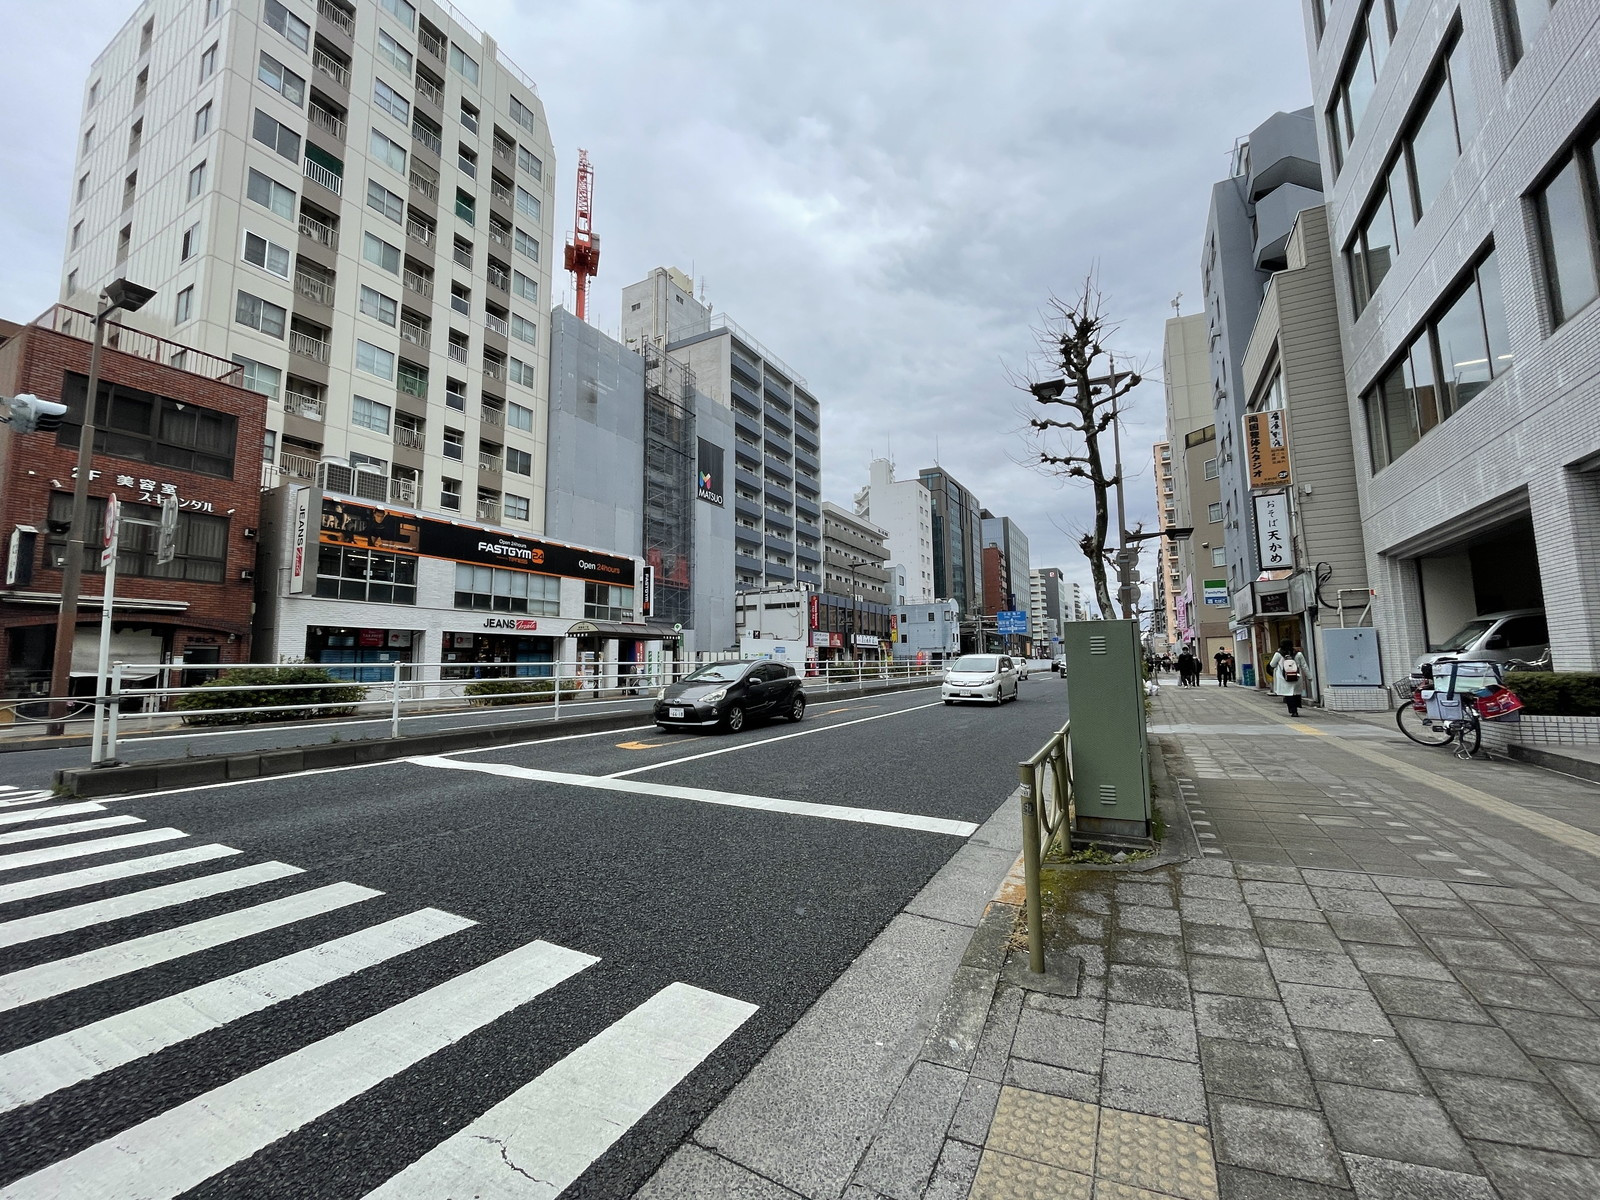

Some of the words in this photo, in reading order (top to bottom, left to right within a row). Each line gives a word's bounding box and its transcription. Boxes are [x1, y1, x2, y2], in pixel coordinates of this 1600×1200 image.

[117, 475, 177, 495] 美容室
[139, 491, 214, 513] スキンダル
[699, 488, 722, 504] MATSUO
[297, 505, 305, 546] JEANS
[478, 542, 532, 559] FASTGYM
[578, 560, 596, 570] Open
[596, 563, 620, 574] 24hours
[483, 618, 515, 629] JEANS
